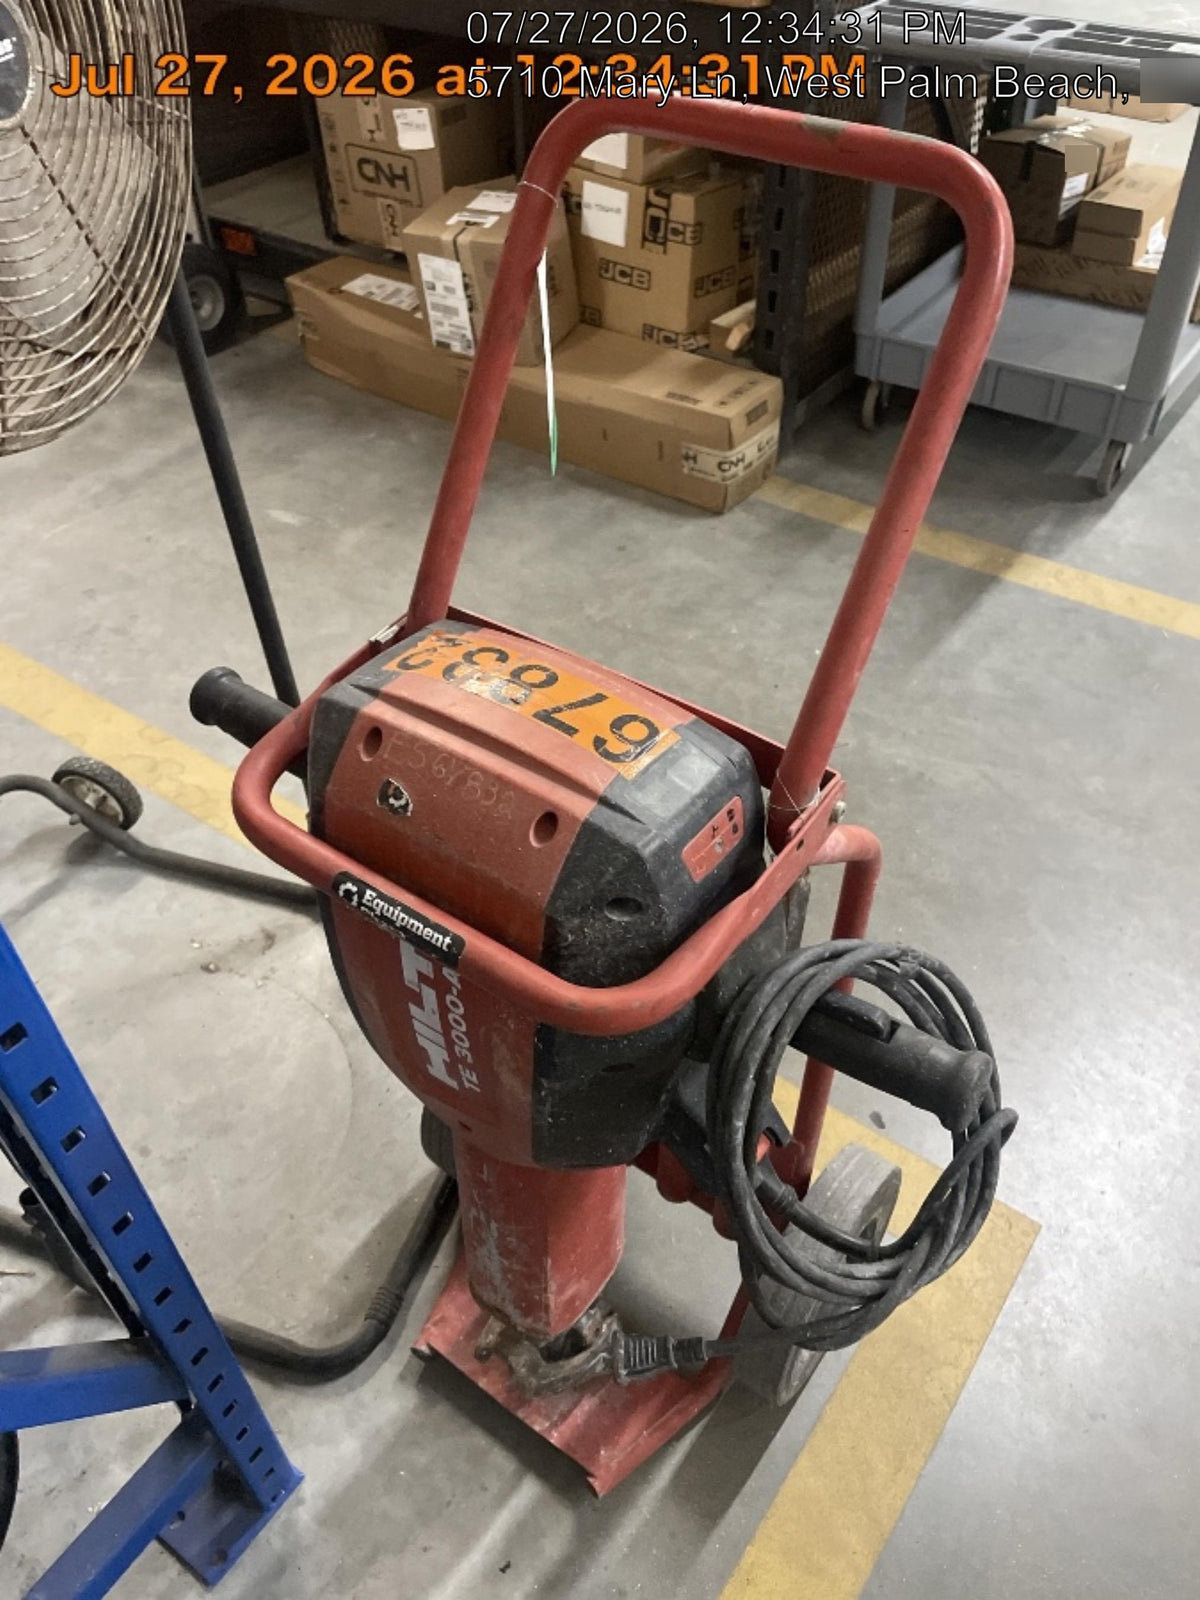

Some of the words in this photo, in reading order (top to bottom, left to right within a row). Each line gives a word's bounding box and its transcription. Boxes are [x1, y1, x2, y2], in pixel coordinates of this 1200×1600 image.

[356, 157, 411, 192] CNH
[600, 259, 650, 290] JCB
[361, 888, 453, 952] Equipment
[400, 938, 460, 1091] HILT
[458, 1063, 481, 1093] TE
